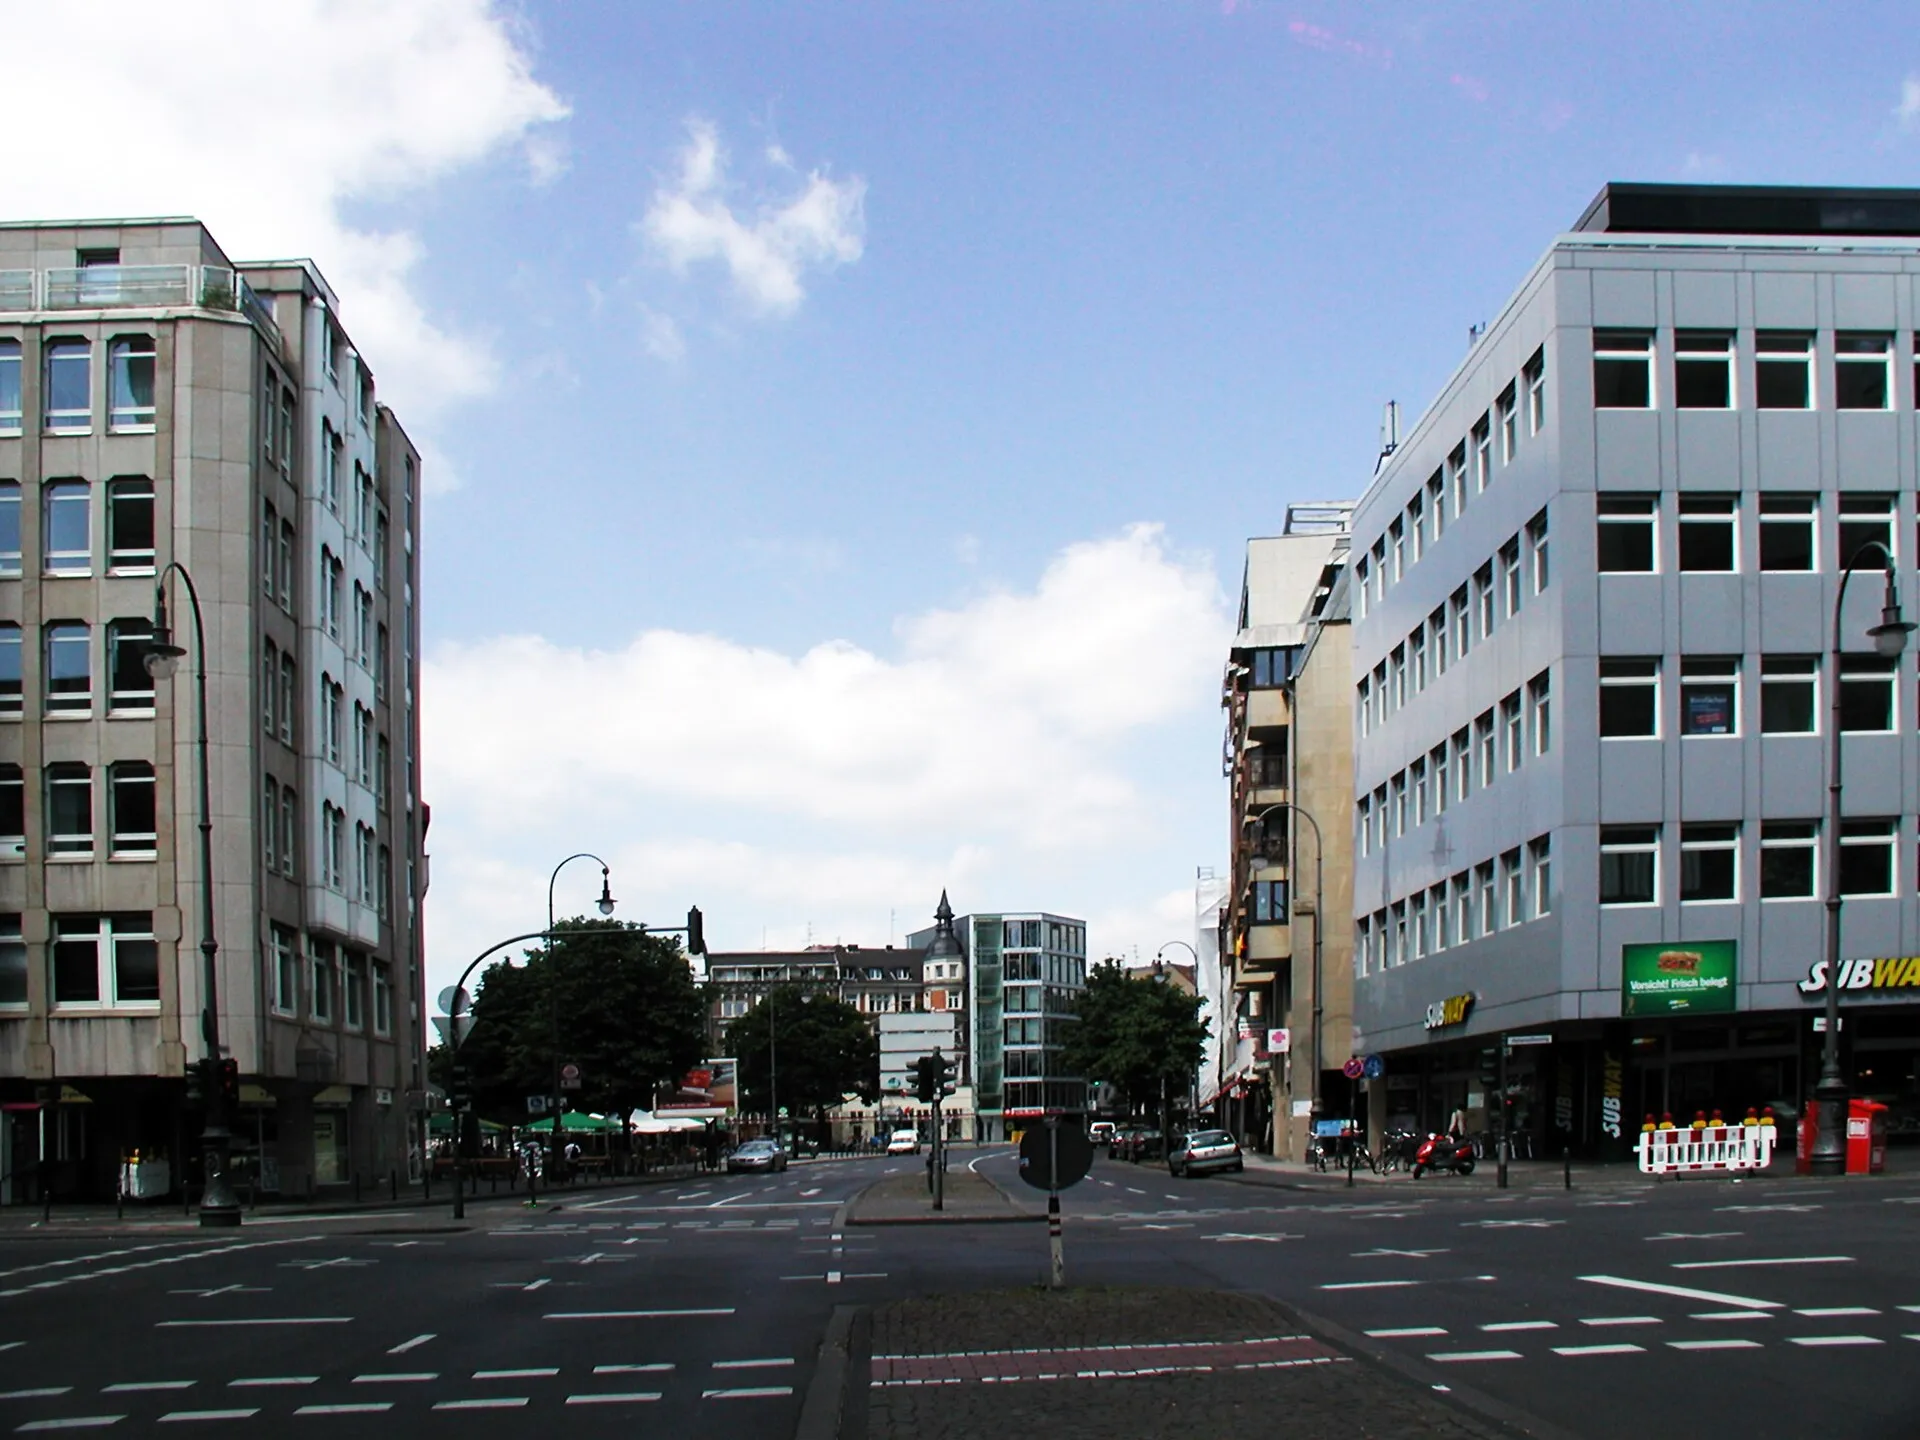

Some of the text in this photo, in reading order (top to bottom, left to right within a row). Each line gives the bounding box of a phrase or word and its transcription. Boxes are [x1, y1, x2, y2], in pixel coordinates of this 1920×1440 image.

[1671, 978, 1698, 988] Frisch
[1424, 993, 1471, 1030] SUBWAY
[1603, 1050, 1622, 1138] SUBWAY
